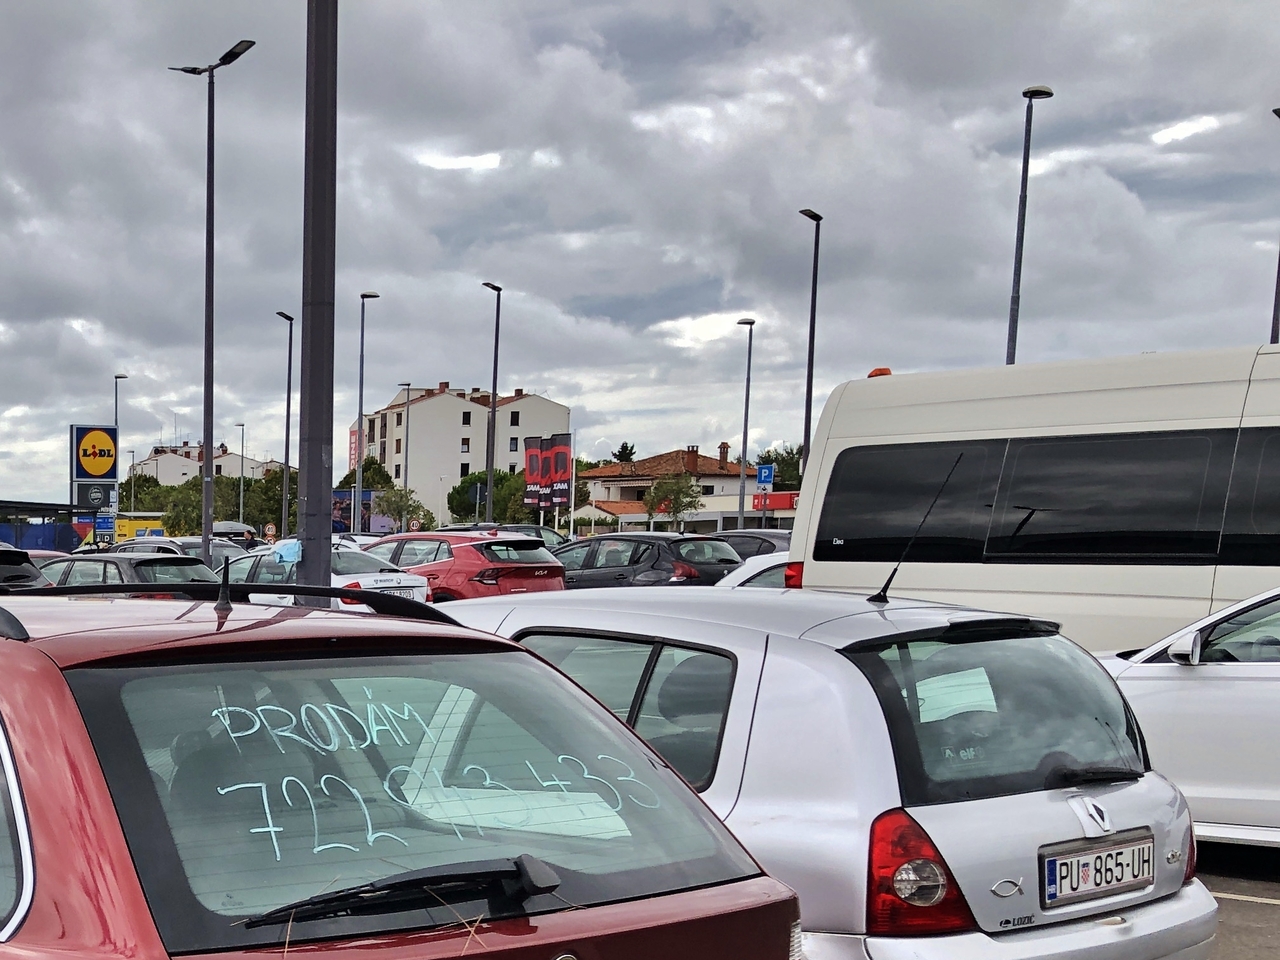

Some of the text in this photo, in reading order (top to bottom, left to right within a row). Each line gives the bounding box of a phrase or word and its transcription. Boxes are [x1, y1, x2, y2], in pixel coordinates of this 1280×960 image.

[82, 444, 113, 459] LIDL
[761, 469, 769, 480] P
[211, 686, 437, 756] PRODÁM
[217, 774, 408, 861] 722
[526, 754, 661, 816] 433
[1058, 845, 1152, 894] PU 865-UH
